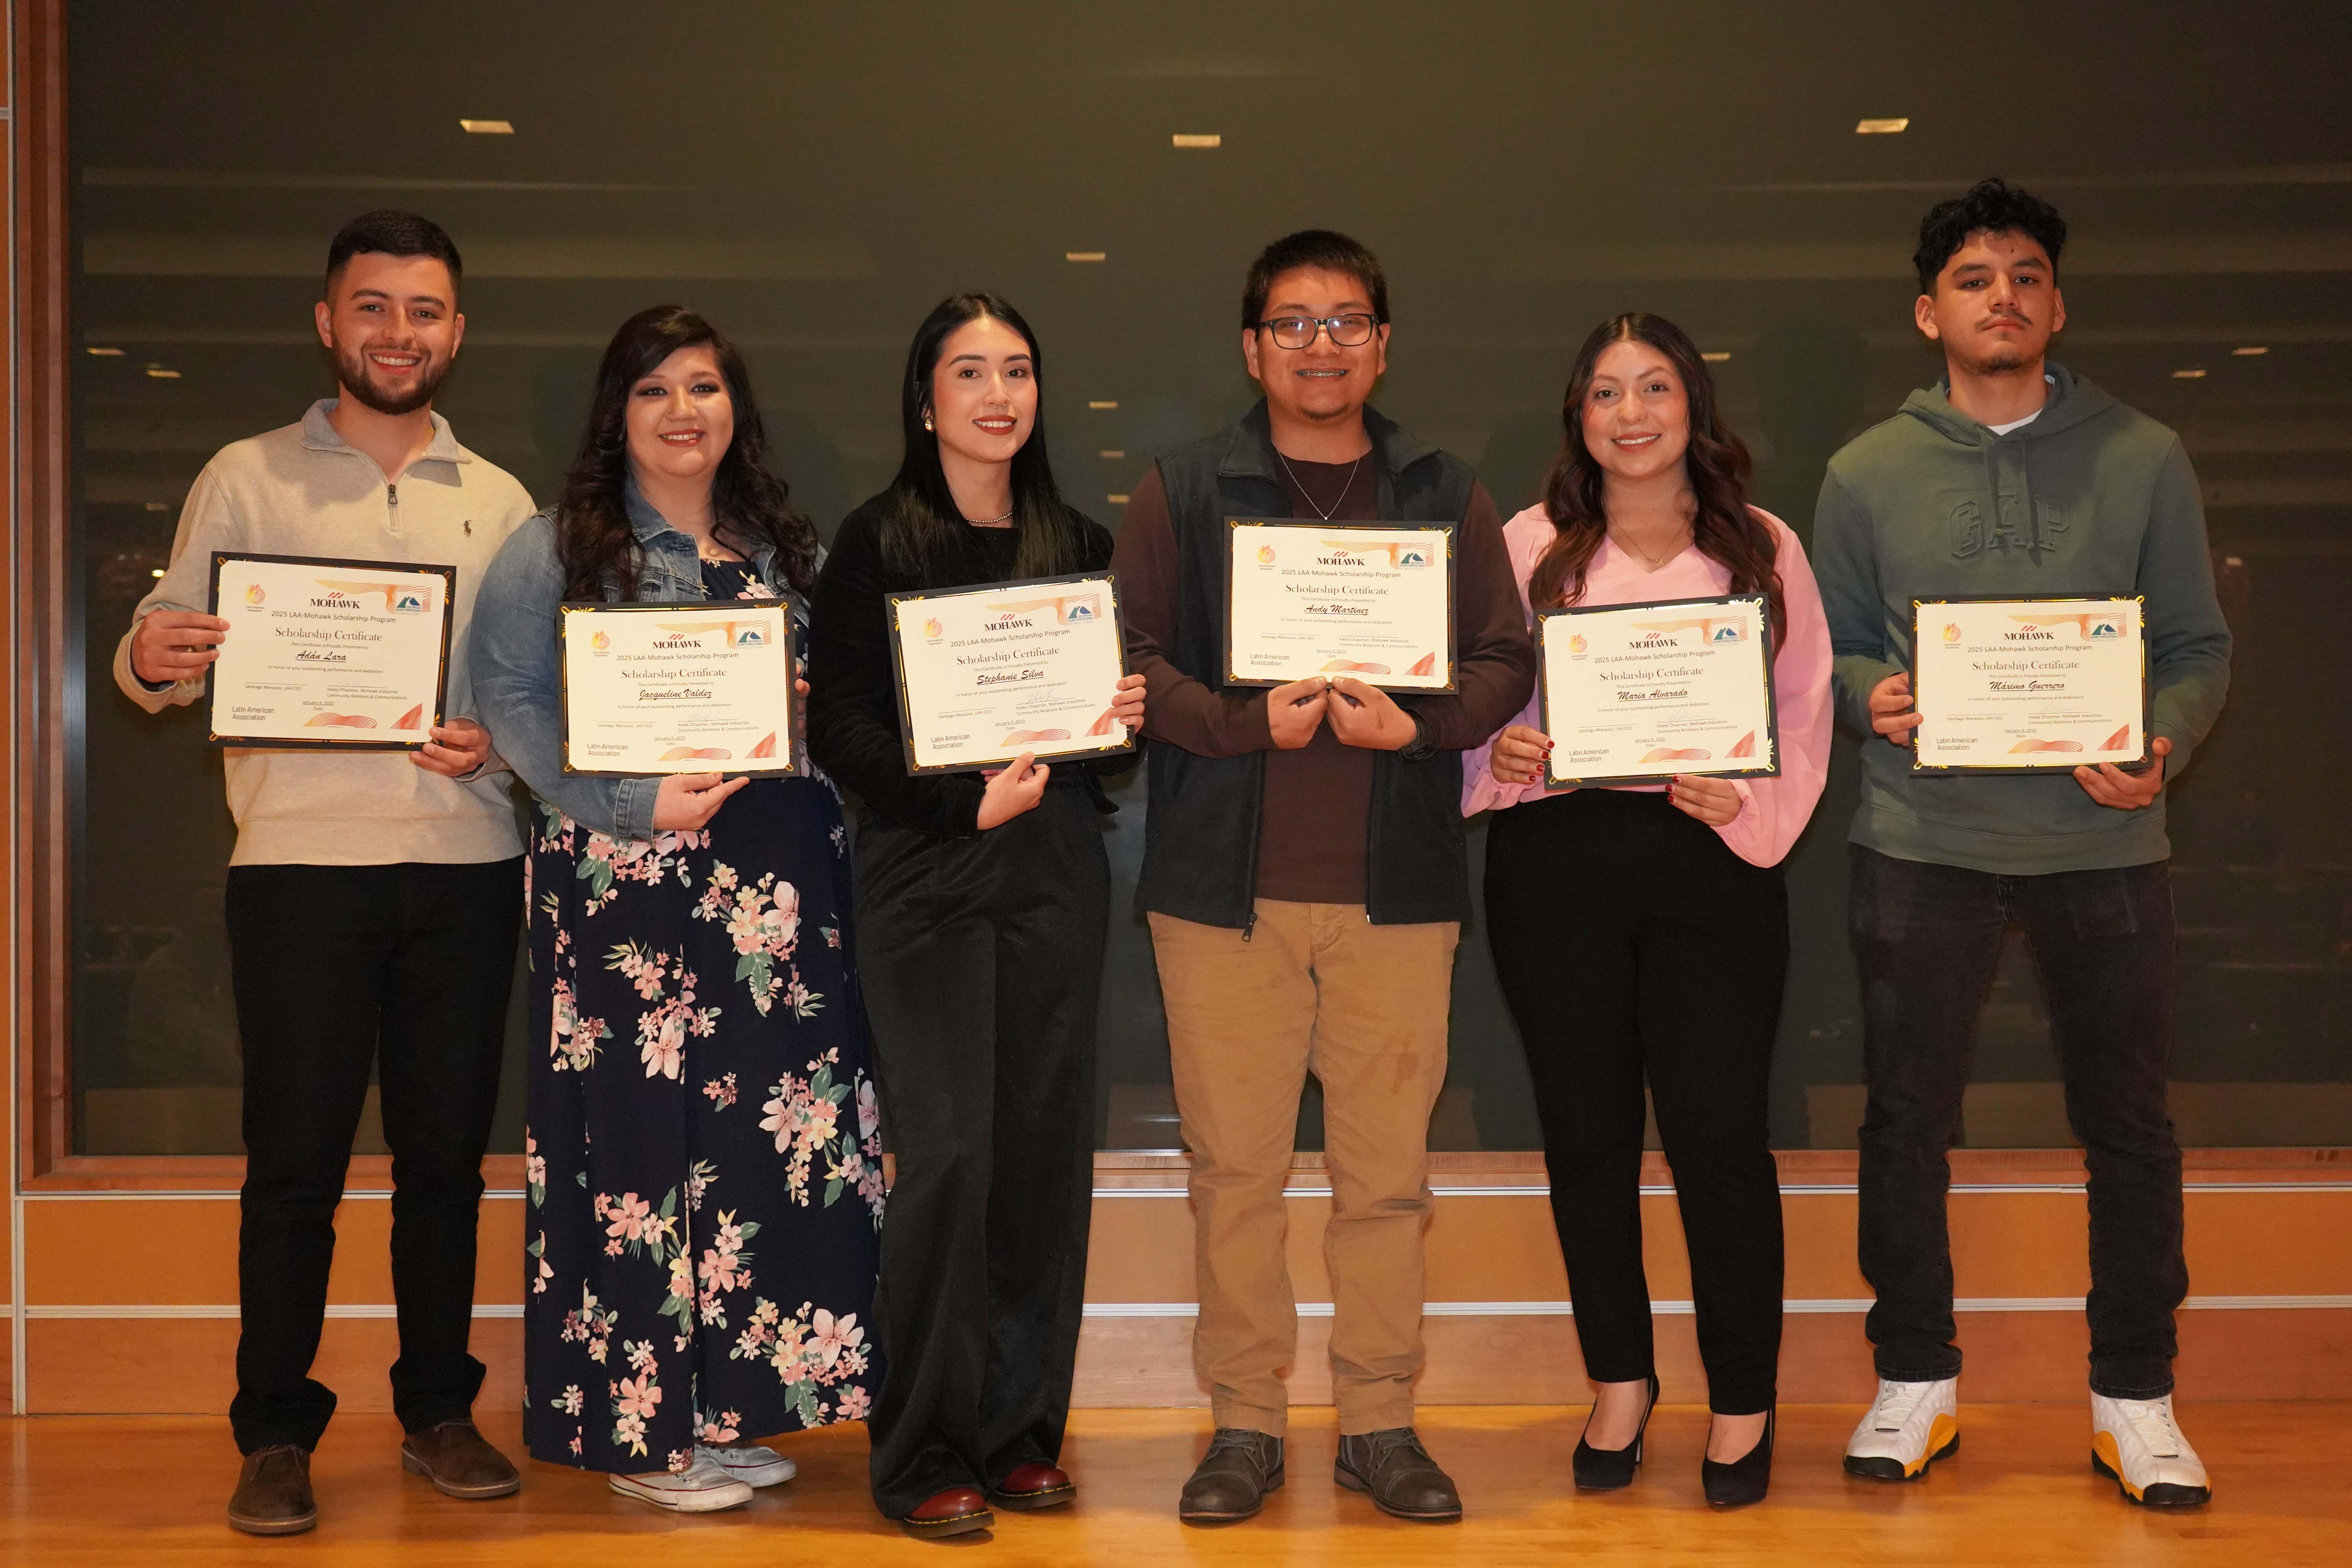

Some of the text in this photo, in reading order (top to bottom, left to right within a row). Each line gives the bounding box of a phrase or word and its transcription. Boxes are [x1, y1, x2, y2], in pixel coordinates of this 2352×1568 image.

[1949, 493, 2070, 558] GAP
[1286, 584, 1388, 595] Scholarship Certificate
[310, 599, 360, 609] MOHAWK
[1304, 604, 1368, 616] Andy Martinez
[333, 614, 368, 622] Scholarship
[985, 619, 1033, 631] MOHAWK
[275, 628, 382, 641] Scholarship Certificate
[967, 636, 1007, 645] LAA-Mohawk
[1009, 632, 1043, 641] Scholarship
[1630, 639, 1677, 649] MOHAWK
[323, 652, 346, 661] Lara
[957, 647, 1059, 665] Scholarship Certificate
[1973, 661, 2079, 671] Scholarship Certificate
[622, 668, 726, 679] Scholarship Certificate
[976, 669, 1043, 684] Stephanie Silva
[1600, 667, 1703, 681] Scholarship Certificate
[1989, 681, 2064, 692] Máximo Guerrero
[639, 689, 711, 701] Jacqueline Valdez
[1648, 688, 1688, 699] Alvarado
